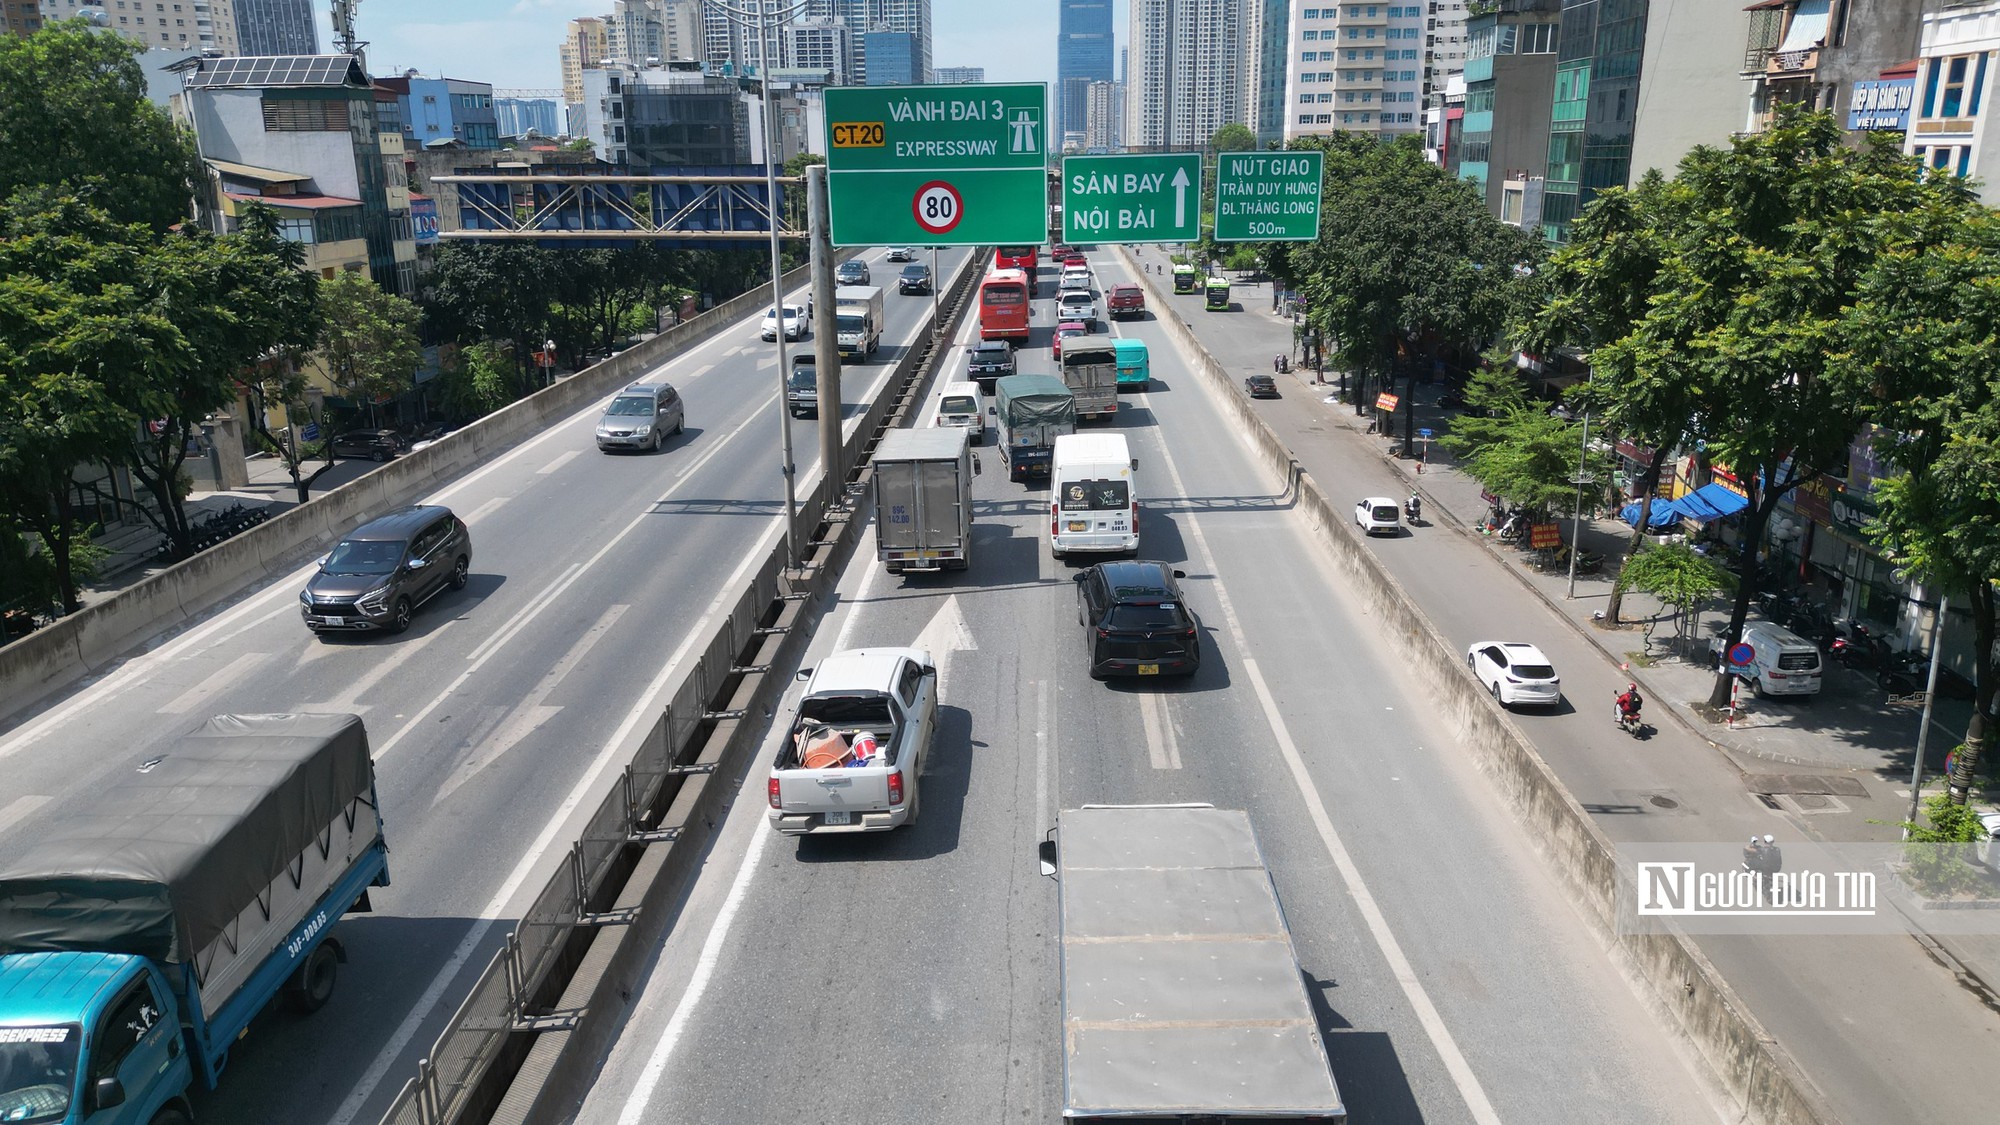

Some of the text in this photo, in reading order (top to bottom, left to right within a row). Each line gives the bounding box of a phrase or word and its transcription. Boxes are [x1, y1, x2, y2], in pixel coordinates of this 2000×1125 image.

[887, 97, 1004, 122] VÀNH ĐAI 3
[1851, 84, 1868, 115] HIỆP
[1856, 117, 1898, 129] VIỆT NAM
[832, 125, 885, 145] CT.20
[895, 140, 998, 157] EXPRESSWAY
[1231, 156, 1310, 176] NÚT GIAO
[1072, 170, 1165, 195] SÂN BAY
[1221, 177, 1318, 196] TRẦN DUY HƯNG
[926, 196, 952, 218] 80
[1221, 201, 1315, 215] ĐL.THĂNG LONG
[1074, 203, 1155, 234] NỘI BÀI
[1248, 222, 1286, 235] 500m
